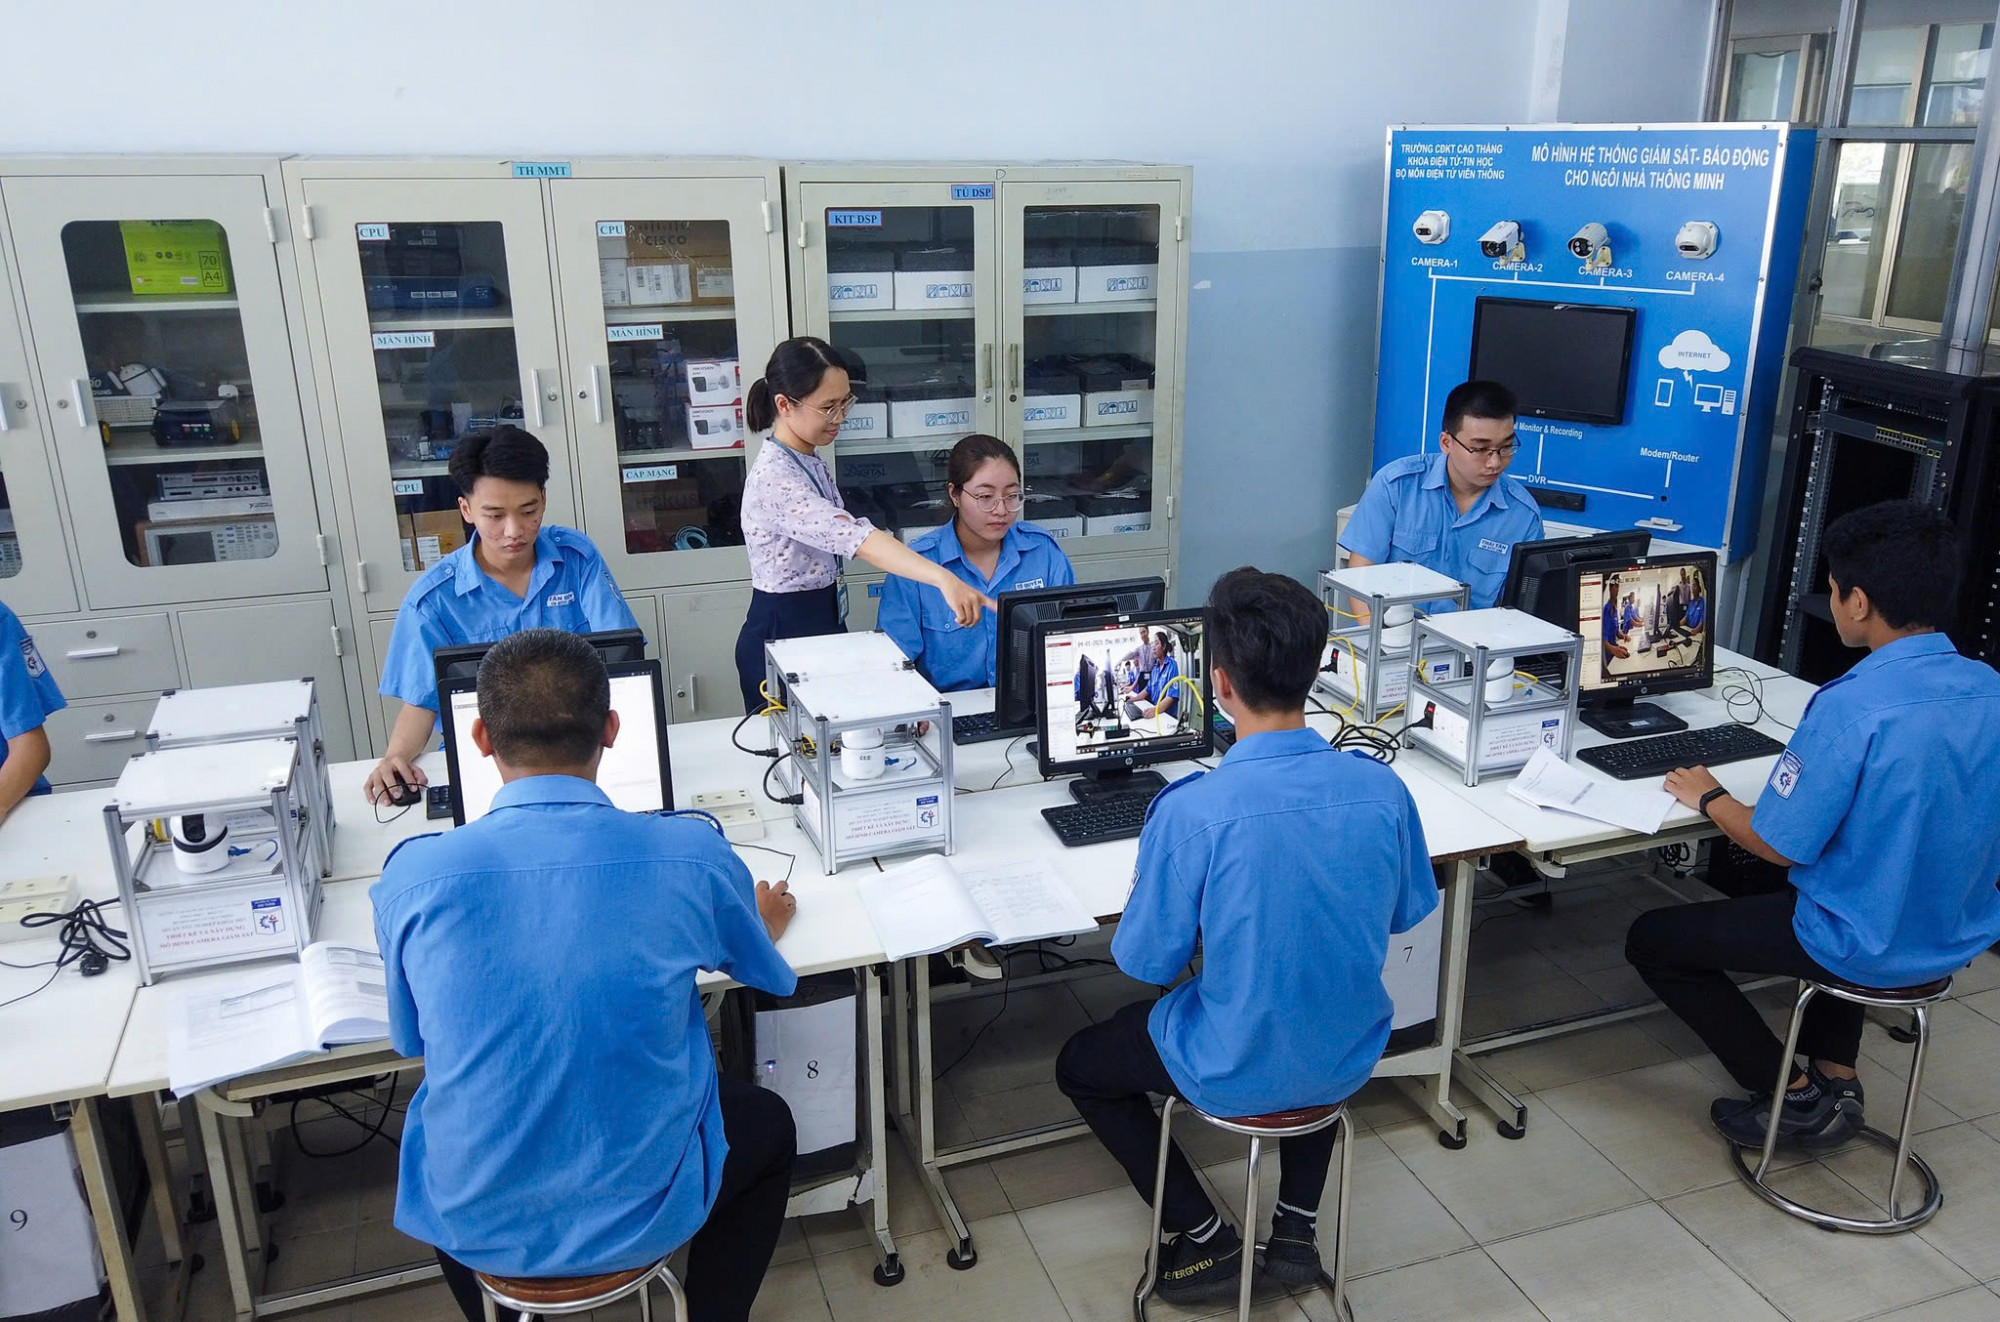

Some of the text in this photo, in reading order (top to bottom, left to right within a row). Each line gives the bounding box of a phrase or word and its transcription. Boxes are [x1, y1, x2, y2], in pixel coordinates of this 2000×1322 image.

[1457, 143, 1474, 154] CAO
[1531, 142, 1549, 162] MÔ
[1579, 144, 1595, 167] HỆ
[1640, 144, 1671, 164] GIÁM
[1702, 144, 1730, 166] BÁO
[1732, 147, 1769, 170] ĐỘNG
[1407, 156, 1429, 166] KHOA
[1476, 157, 1494, 168] HỌC
[517, 166, 568, 176] TH MMT
[1564, 169, 1589, 186] CHO
[1591, 167, 1620, 187] NGÔI
[1649, 168, 1691, 190] THÔNG
[1693, 172, 1725, 190] MINH
[972, 187, 991, 198] DSP
[834, 215, 878, 224] KIT DSP
[359, 227, 385, 238] CPU
[600, 225, 623, 235] CPU
[646, 235, 687, 246] CISCO
[202, 255, 217, 266] 70
[1411, 257, 1458, 268] CAMERA-1
[204, 271, 220, 281] A4
[1666, 270, 1725, 282] CAMERA-4
[1677, 351, 1711, 359] INTERNET
[1519, 421, 1542, 433] Monitor
[1543, 425, 1549, 434] &
[1550, 425, 1583, 440] Recording
[1640, 446, 1700, 463] Modem/Router
[647, 468, 675, 478] MẠNG
[1528, 474, 1547, 485] DVR
[395, 483, 419, 493] CPU
[1403, 946, 1413, 964] 7
[807, 1060, 819, 1079] 8
[9, 1209, 28, 1232] 9
